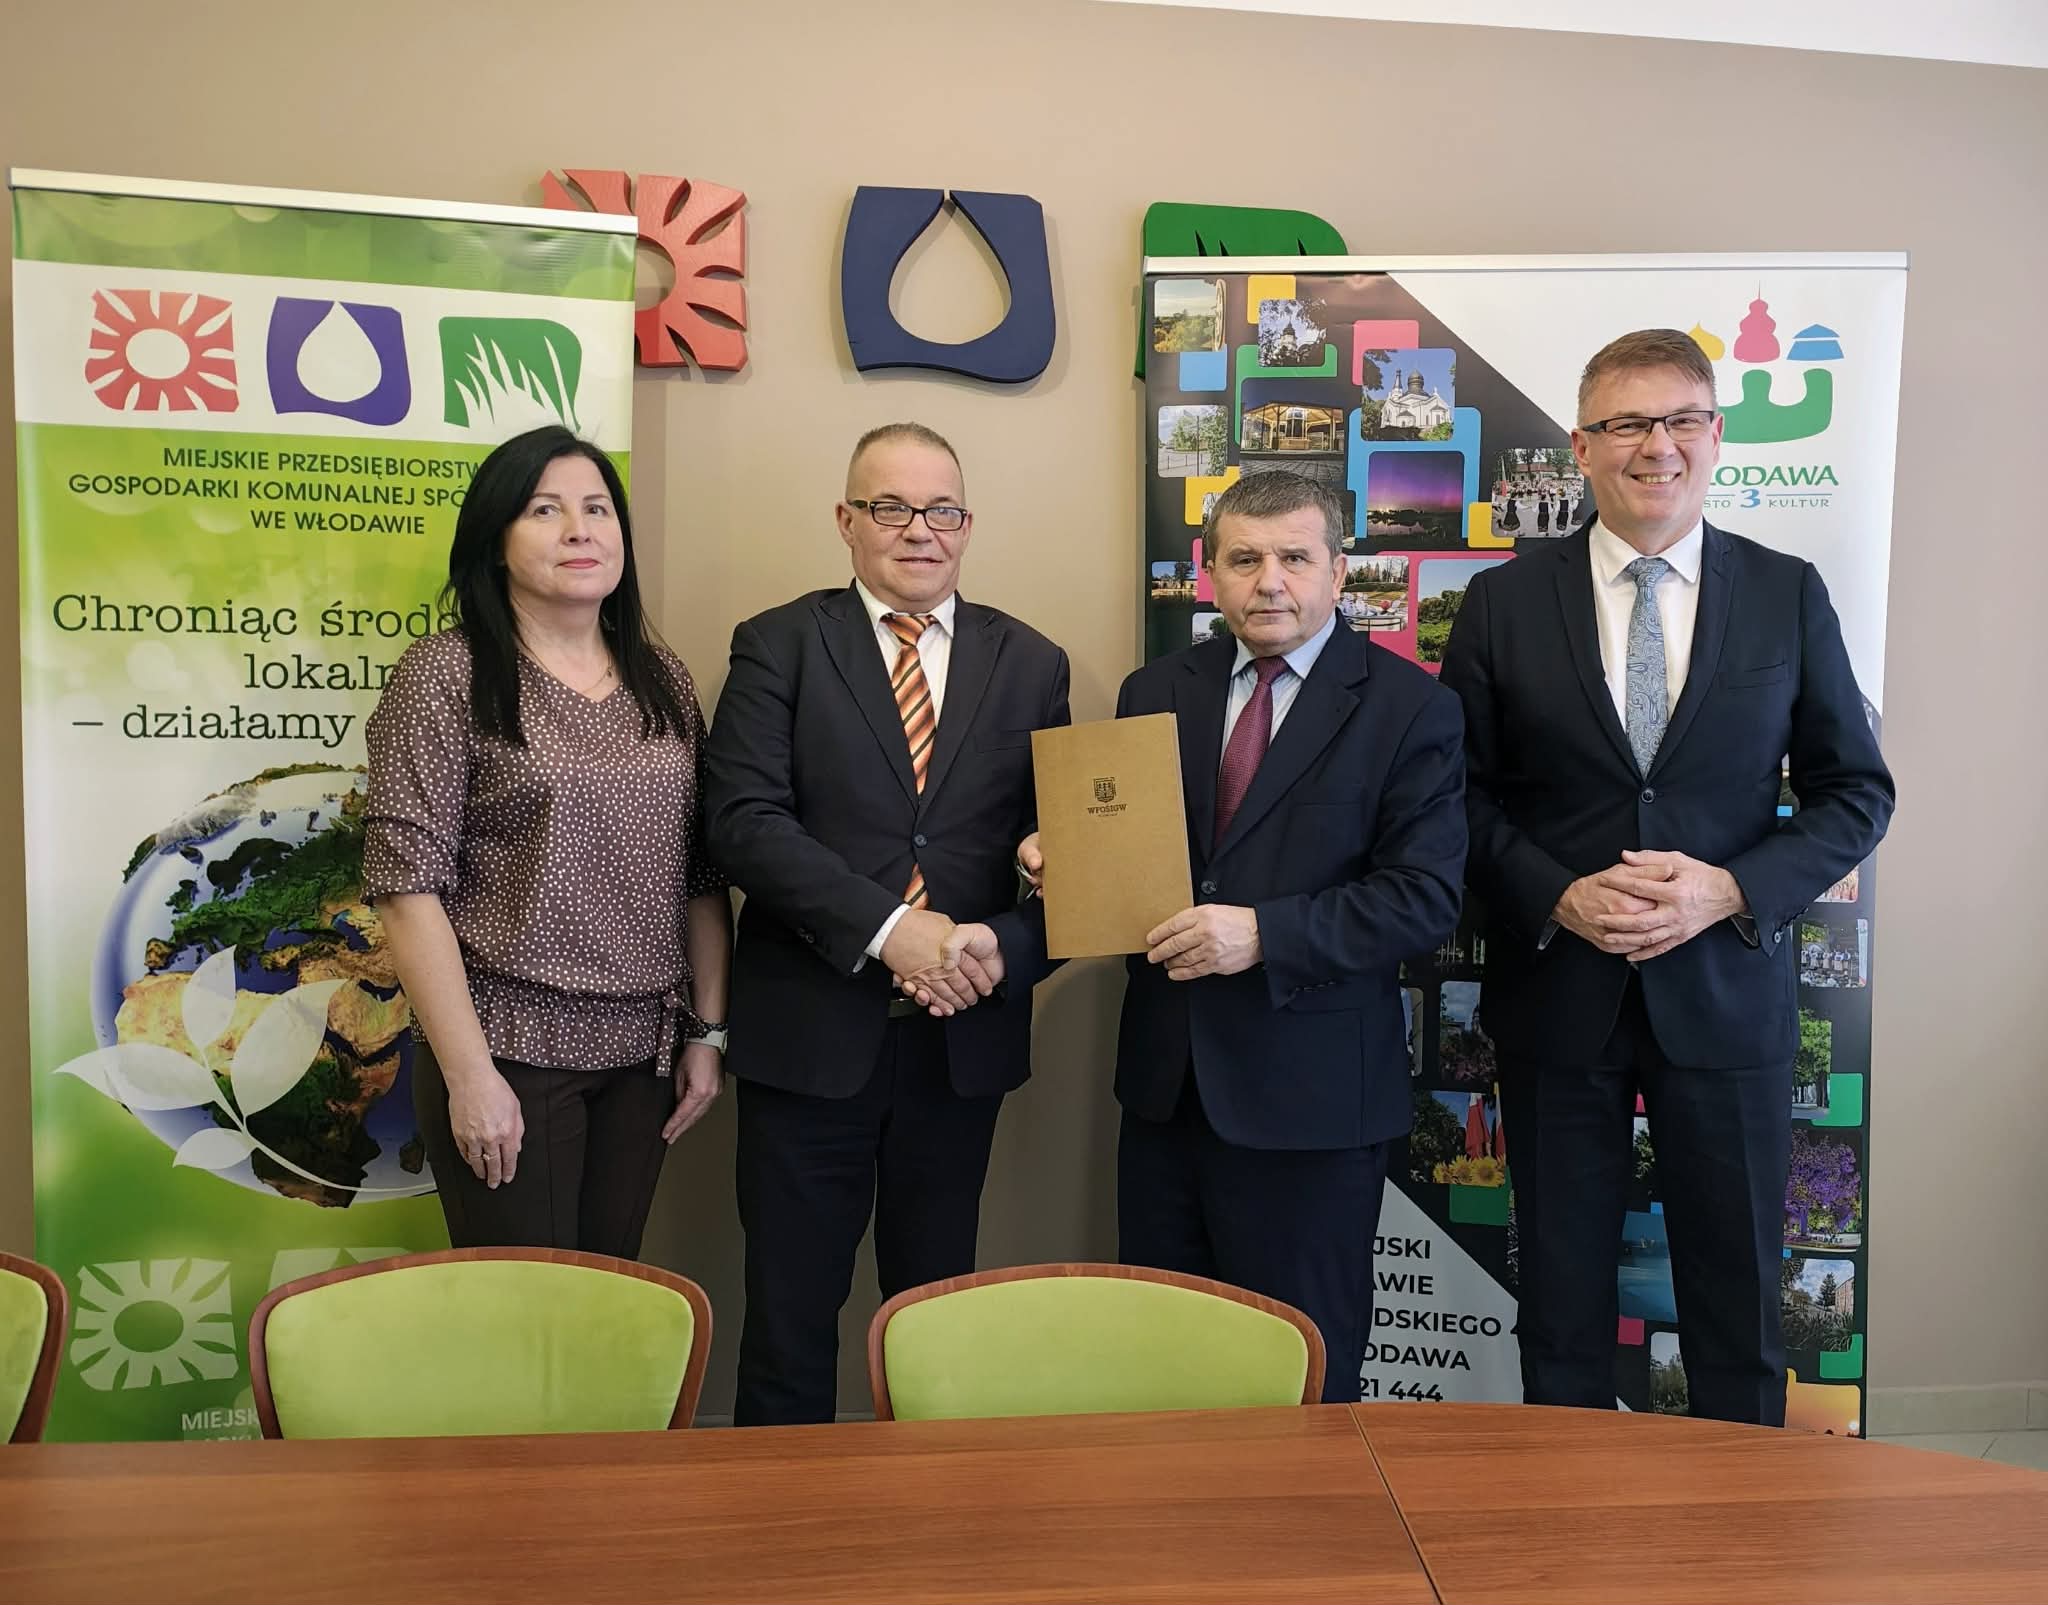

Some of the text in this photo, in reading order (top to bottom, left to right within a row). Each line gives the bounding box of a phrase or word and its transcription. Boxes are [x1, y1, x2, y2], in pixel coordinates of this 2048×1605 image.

[164, 448, 269, 470] MIEJSKIE
[1710, 465, 1839, 486] ODAWA
[69, 474, 467, 508] GOSPODARKI KOMUNALNEJ SPÓ
[1740, 489, 1761, 508] 3
[1768, 499, 1830, 508] KULTUR
[251, 510, 425, 534] WE WŁODAWIE
[53, 594, 297, 642] Chroniąc
[123, 704, 356, 748] działamy
[1374, 1307, 1501, 1336] DSKIEGO
[1388, 1380, 1443, 1402] 444
